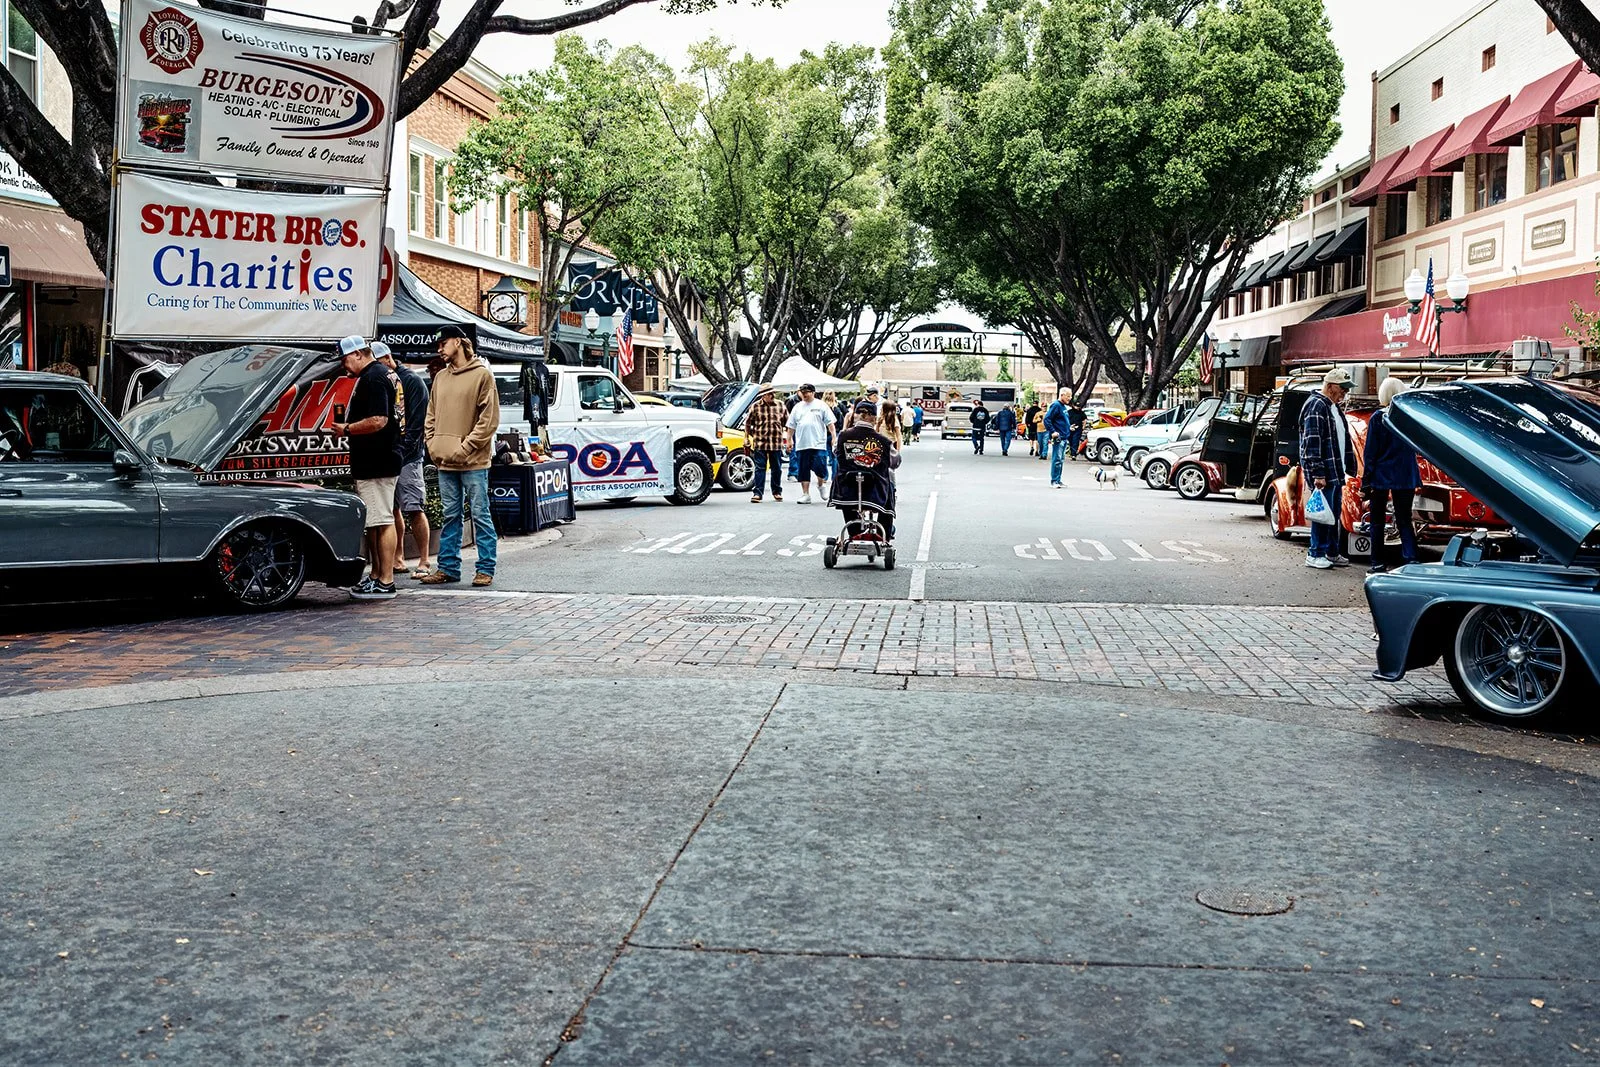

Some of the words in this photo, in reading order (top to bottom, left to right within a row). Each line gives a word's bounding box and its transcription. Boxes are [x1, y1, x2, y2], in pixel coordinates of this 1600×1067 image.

[158, 12, 189, 23] LOYALTY
[145, 21, 154, 50] HONOR
[191, 30, 199, 57] PRIDE
[221, 28, 308, 58] Celebrating
[312, 46, 332, 61] 75
[333, 49, 376, 66] Years!
[155, 57, 187, 68] COURAGE
[198, 68, 357, 108] BURGESON'S
[207, 91, 255, 107] HEATING
[261, 100, 280, 111] A/C
[286, 102, 341, 119] ELECTRICAL
[223, 105, 261, 119] SOLAR
[269, 112, 321, 126] PLUMBING
[216, 136, 262, 156] Family
[266, 142, 304, 158] Owned
[307, 147, 317, 158] &
[320, 149, 365, 165] Operated
[347, 137, 366, 148] Since
[366, 139, 380, 149] 1949
[22, 179, 46, 193] Chines
[140, 203, 277, 243] STATER
[283, 215, 366, 248] BROS.
[152, 245, 353, 296] Charities
[147, 293, 189, 310] Caring
[193, 294, 209, 309] for
[212, 296, 235, 310] The
[238, 297, 310, 311] Communities
[312, 299, 328, 311] We
[331, 299, 357, 312] Serve
[252, 455, 350, 469] SILKSCREENING
[535, 468, 569, 497] RPOA
[571, 484, 606, 492] FFICERS
[607, 481, 658, 490] ASSOCIATION
[1013, 537, 1229, 562] STOP
